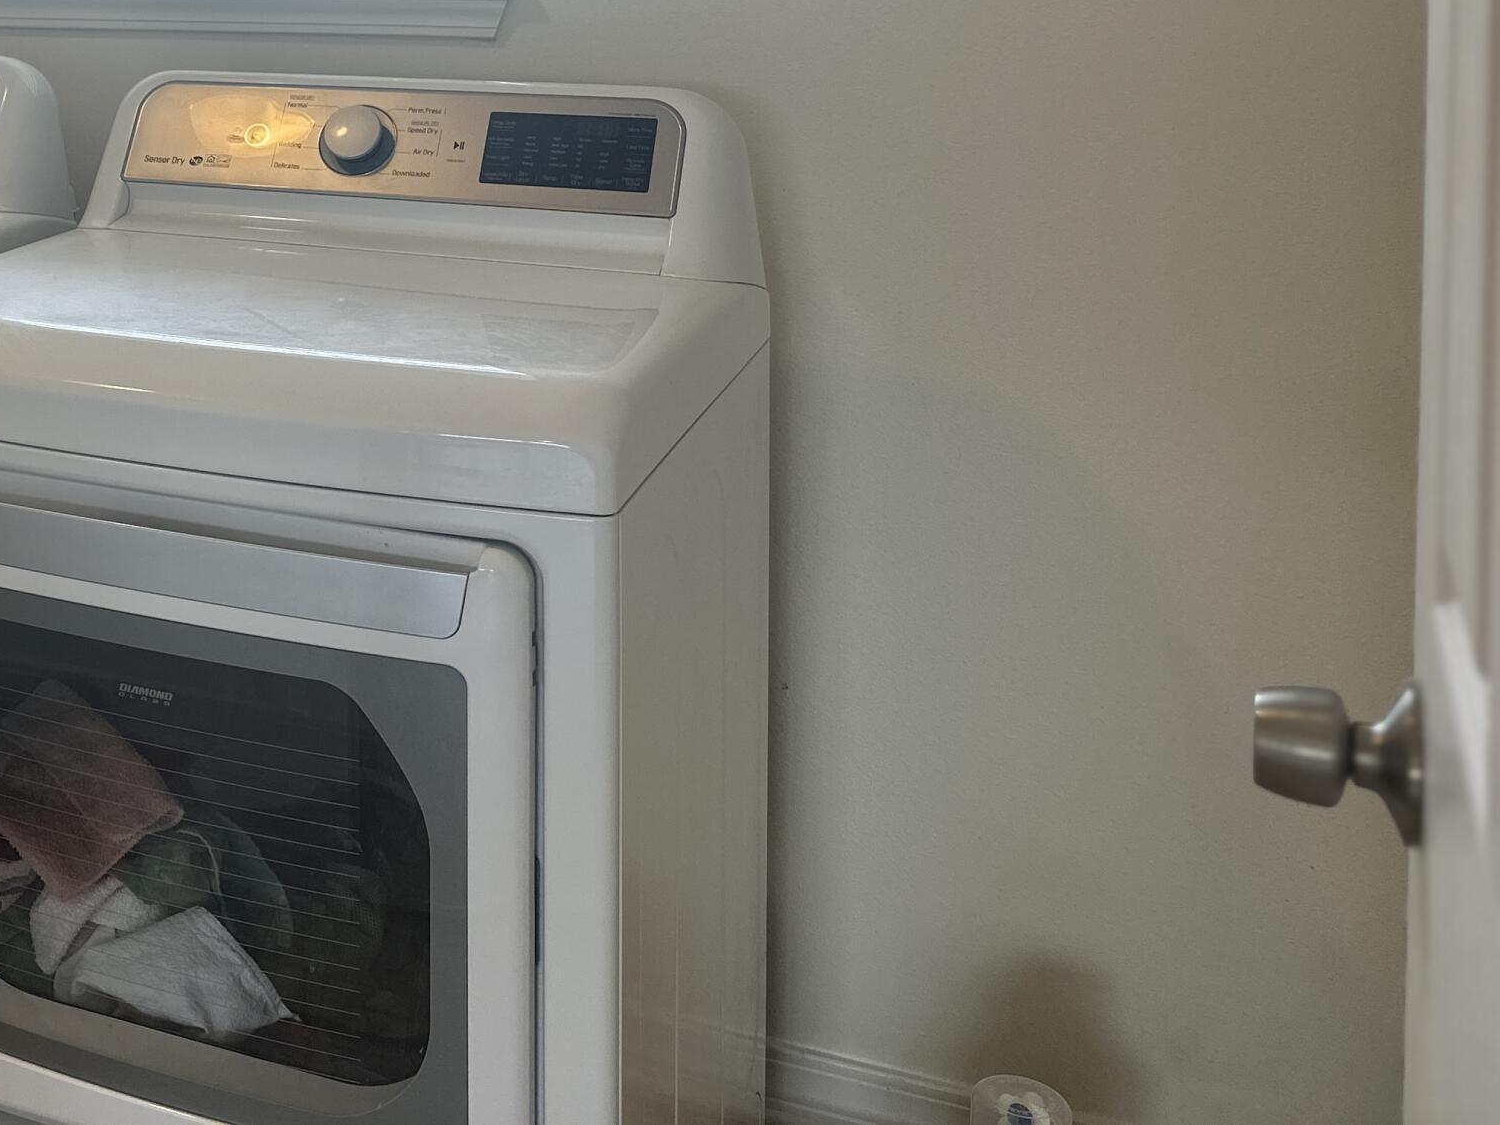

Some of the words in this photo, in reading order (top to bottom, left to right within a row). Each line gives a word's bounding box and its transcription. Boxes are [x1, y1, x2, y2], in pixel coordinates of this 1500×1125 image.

[427, 127, 438, 135] Dry
[422, 148, 434, 156] Dry
[144, 154, 171, 165] Sensor
[171, 156, 186, 167] Dry
[392, 169, 431, 178] Downloaded
[118, 682, 174, 702] DIAMOND
